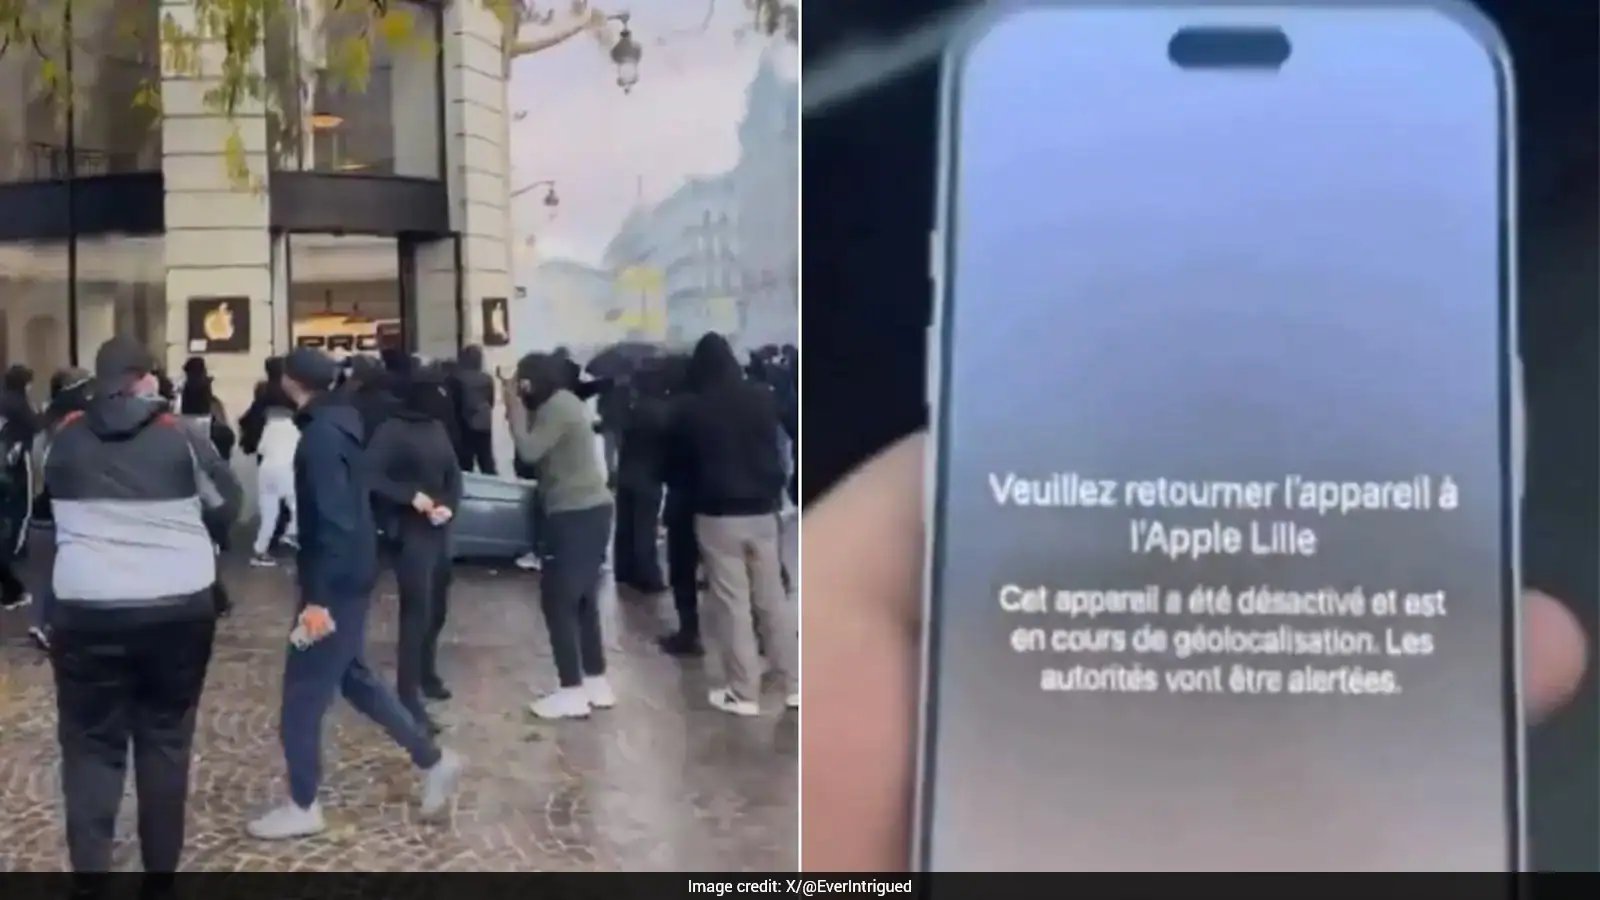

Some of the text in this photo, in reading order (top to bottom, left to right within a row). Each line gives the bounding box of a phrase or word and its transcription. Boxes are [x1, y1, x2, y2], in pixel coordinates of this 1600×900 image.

[989, 473, 1459, 514] Veuillez retourner l'appareil à
[1130, 519, 1317, 559] l'Apple Lille
[999, 585, 1447, 618] Cet appareil a été désactivé et est
[1010, 628, 1045, 652] en
[1051, 628, 1126, 654] cours
[1132, 625, 1167, 653] de
[1386, 627, 1434, 656] Les
[1040, 664, 1402, 696] autorités vont être alertées.
